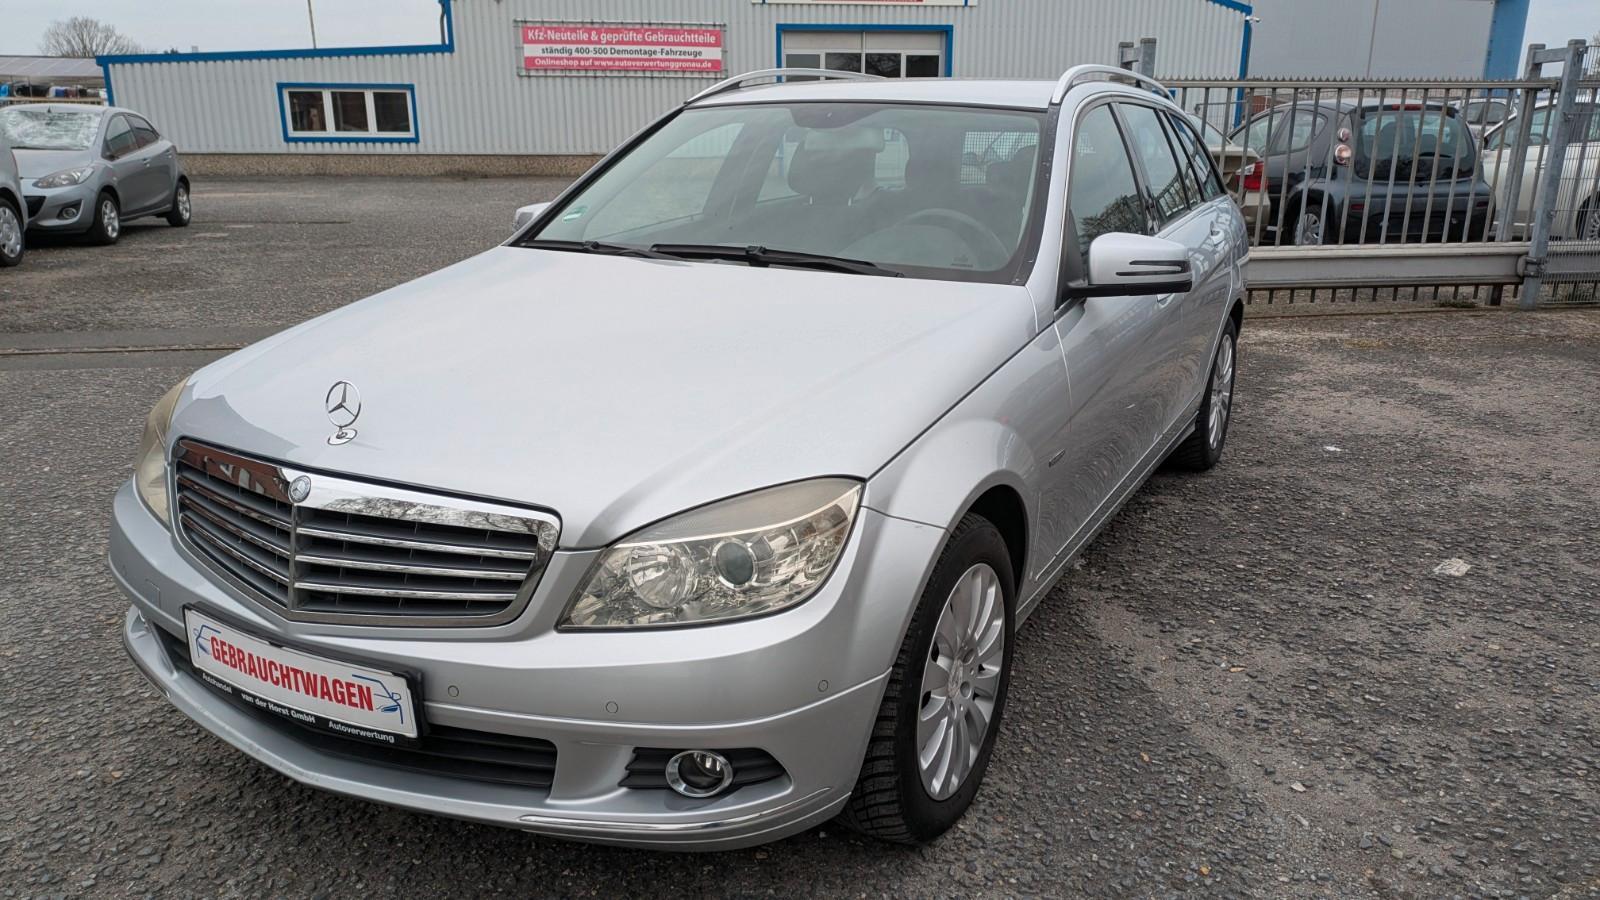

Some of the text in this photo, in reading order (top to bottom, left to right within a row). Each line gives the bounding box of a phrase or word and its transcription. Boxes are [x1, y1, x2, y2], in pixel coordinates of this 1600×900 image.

[527, 29, 716, 44] Kfz-Neuteile & geprüfte Gebrauchtteile
[541, 46, 703, 58] ständig 400-500 Demontage-Fahrzeuge
[534, 58, 579, 66] Onlineshop
[580, 58, 593, 66] auf
[210, 635, 374, 712] GEBRAUCHTWAGEN
[241, 692, 254, 703] van
[255, 698, 267, 708] der
[268, 702, 289, 716] Horst
[290, 709, 316, 724] GmbH
[328, 720, 395, 744] Autoverwertung
